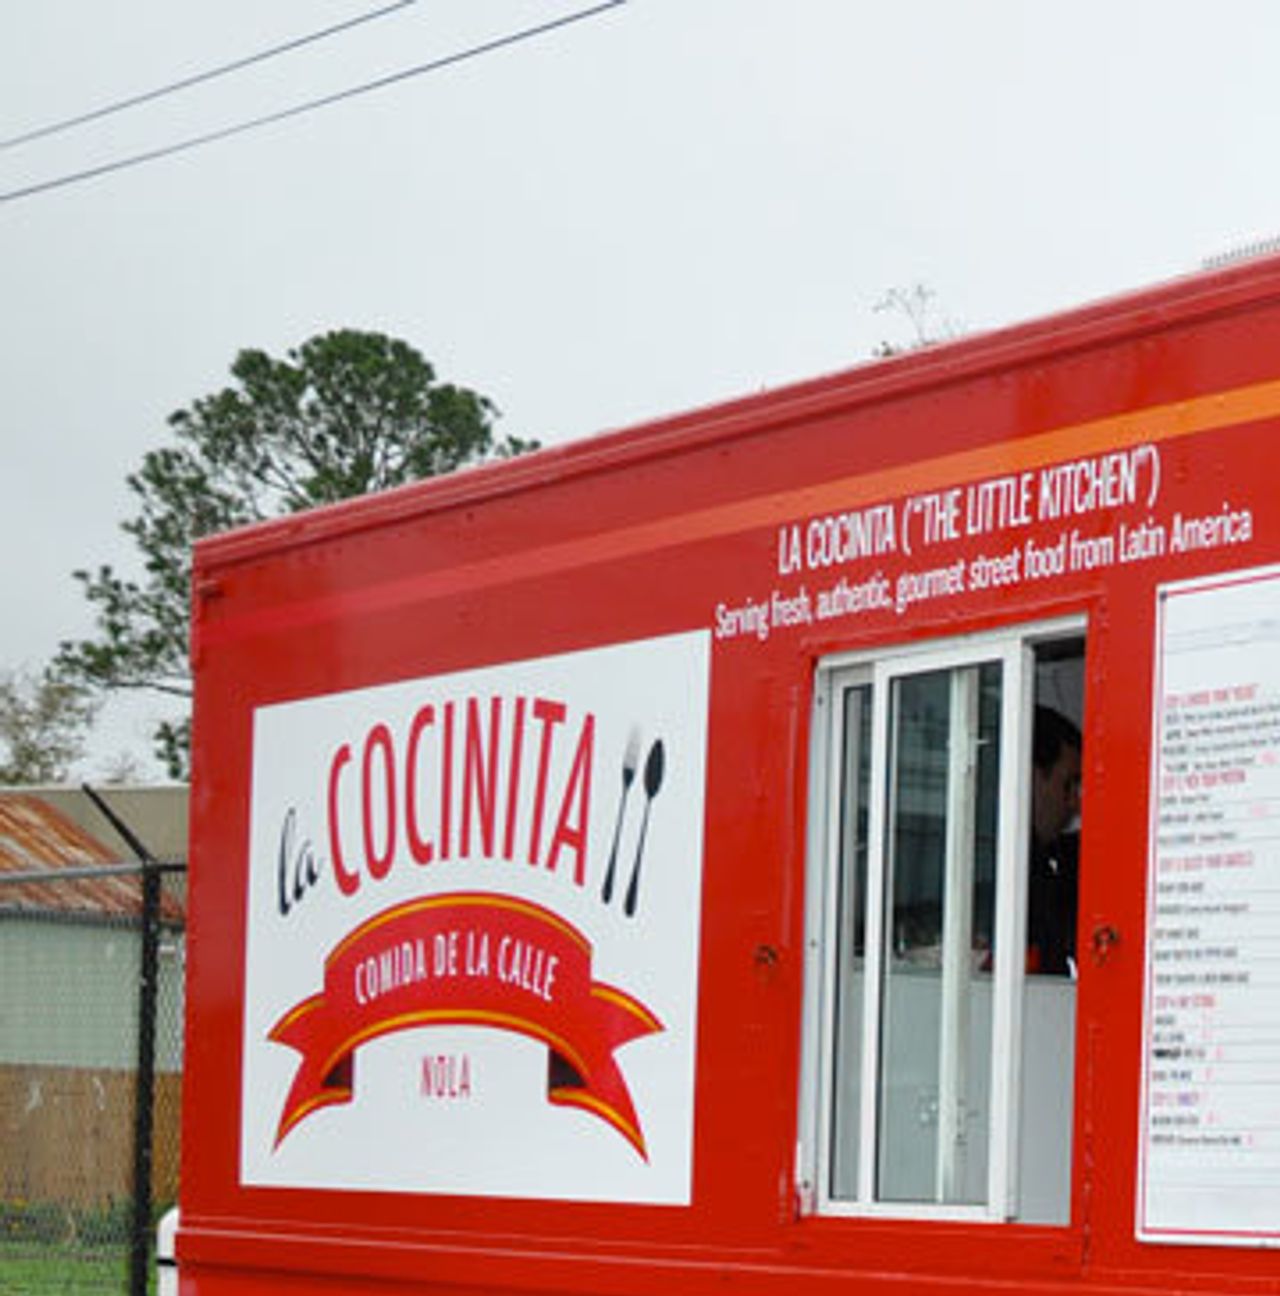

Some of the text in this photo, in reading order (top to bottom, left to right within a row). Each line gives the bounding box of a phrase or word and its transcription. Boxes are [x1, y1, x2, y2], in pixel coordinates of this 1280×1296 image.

[715, 597, 769, 642] Serving
[771, 585, 813, 626] fresh,
[895, 562, 965, 614] gourmet
[968, 546, 1021, 593] street
[1024, 537, 1066, 582] food
[1069, 529, 1114, 572] from
[1118, 508, 1167, 564] Latin
[1169, 500, 1253, 555] America
[777, 526, 802, 575] LA
[806, 502, 897, 570] COCINITA
[965, 470, 1032, 536] LITTLE
[326, 696, 596, 898] COCINITA
[354, 929, 560, 1005] COMIDA DE LA CALLE
[420, 1052, 471, 1099] NOLA
